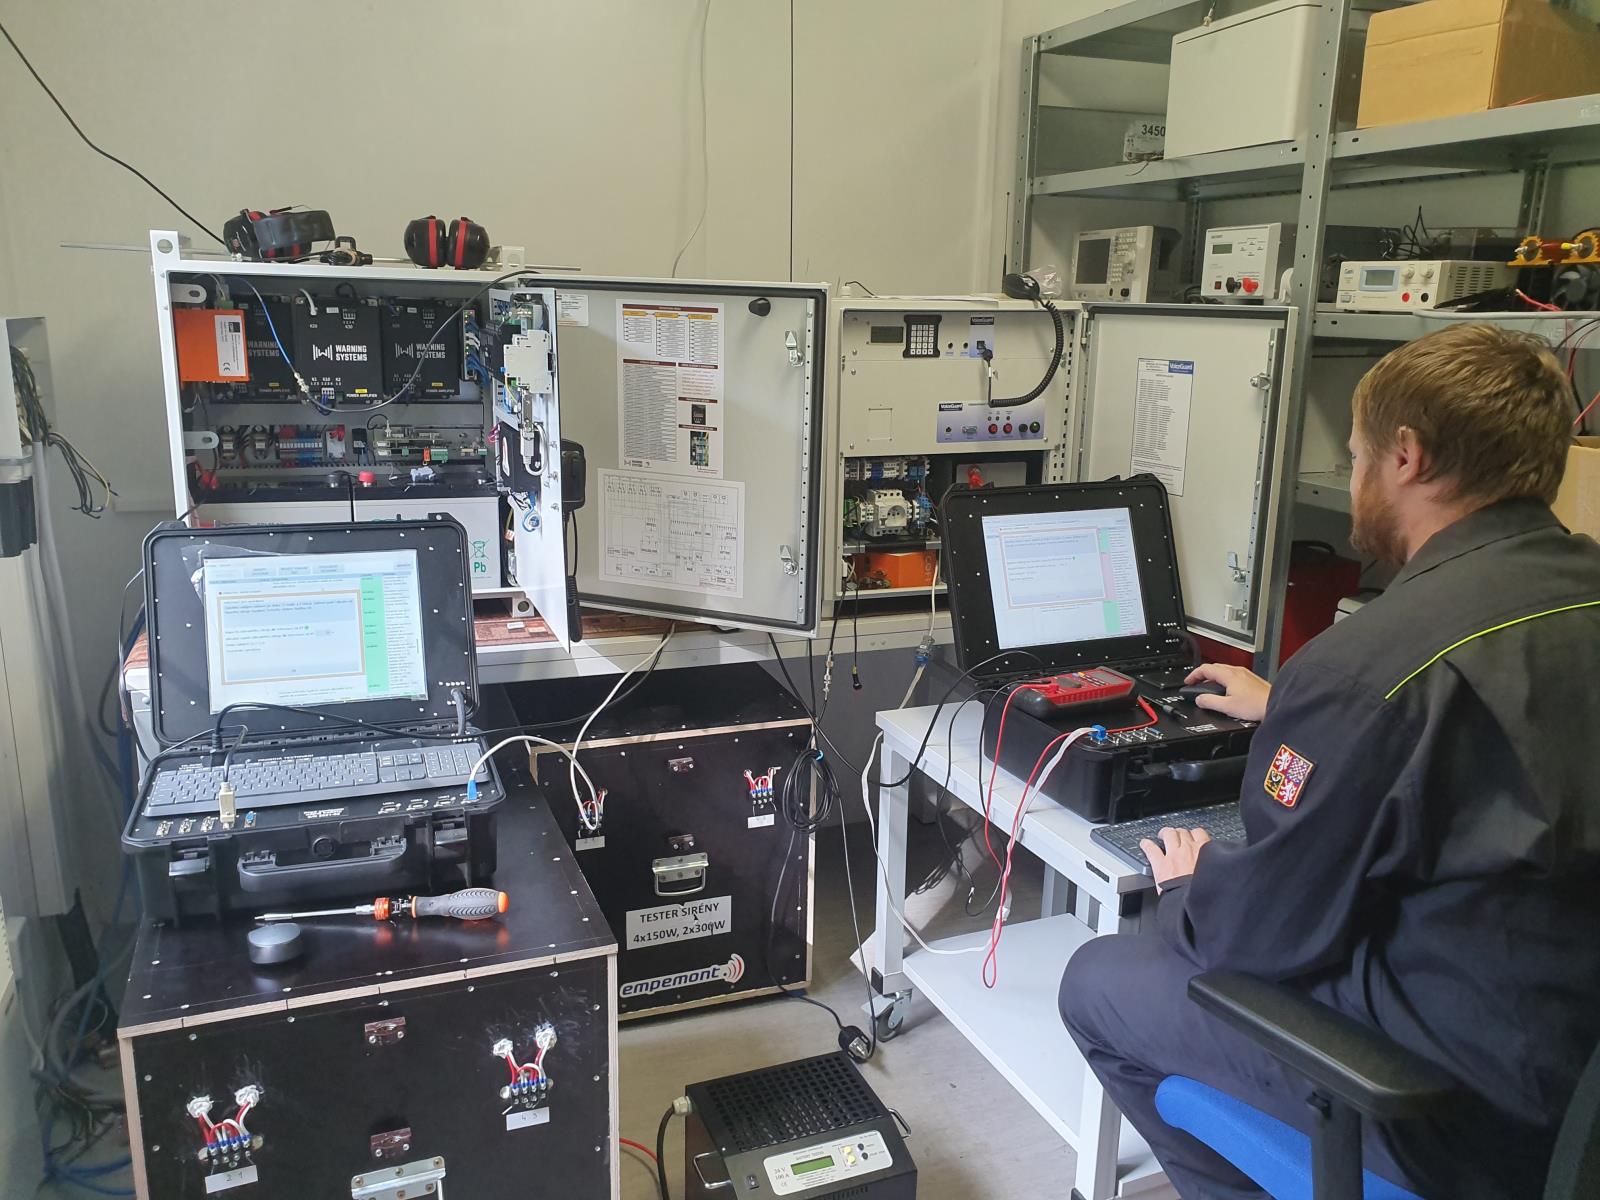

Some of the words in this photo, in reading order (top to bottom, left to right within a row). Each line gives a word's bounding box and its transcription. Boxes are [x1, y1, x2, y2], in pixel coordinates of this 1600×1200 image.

[335, 344, 368, 353] WARNING
[335, 353, 368, 362] SYSTEMS
[473, 561, 487, 573] Pb
[640, 909, 678, 923] TESTER
[681, 902, 720, 916] SIRÉNY
[633, 927, 680, 943] 4x150W,
[682, 919, 726, 935] 2x300W
[622, 967, 721, 995] empemont
